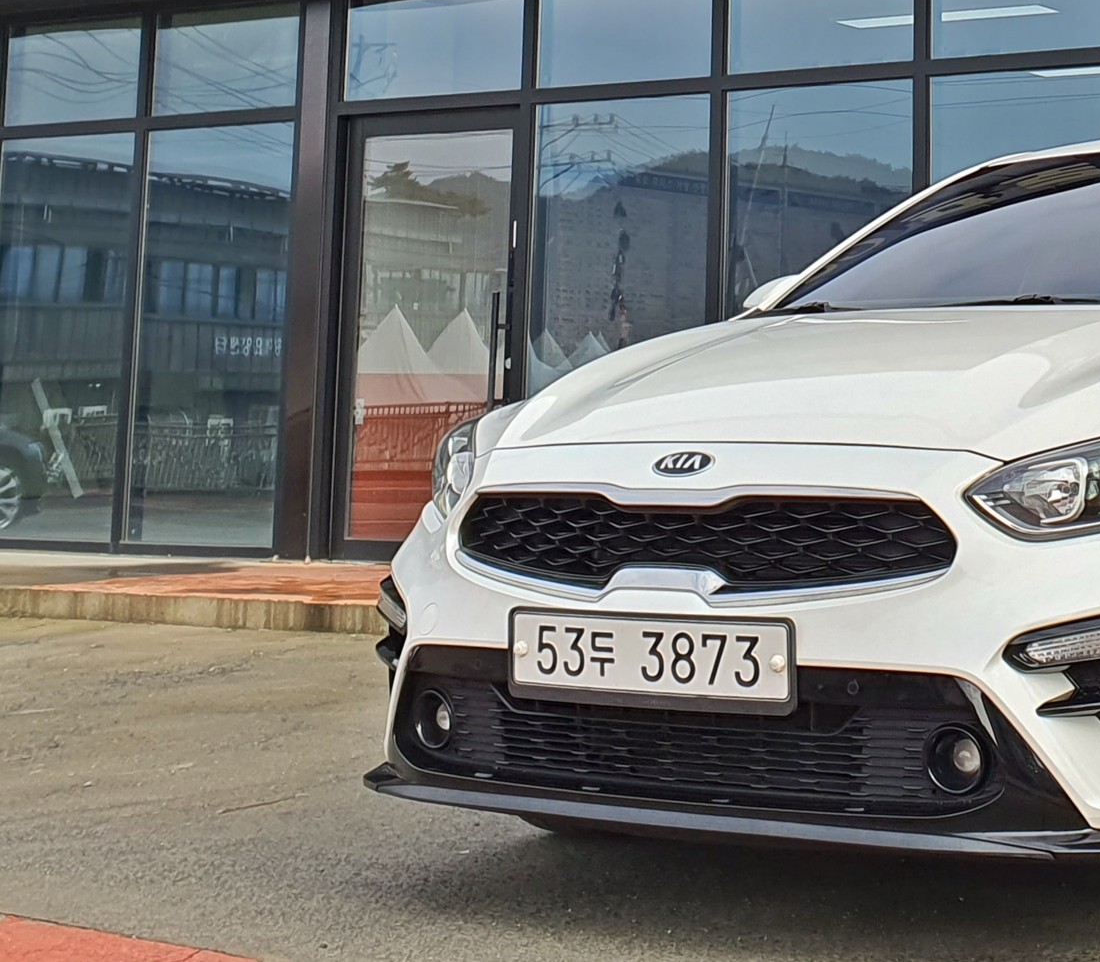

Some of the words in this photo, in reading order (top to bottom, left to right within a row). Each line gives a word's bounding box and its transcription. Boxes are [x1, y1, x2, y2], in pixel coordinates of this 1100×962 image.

[660, 453, 703, 469] KIA
[536, 625, 615, 677] 53두
[641, 631, 760, 687] 3873
